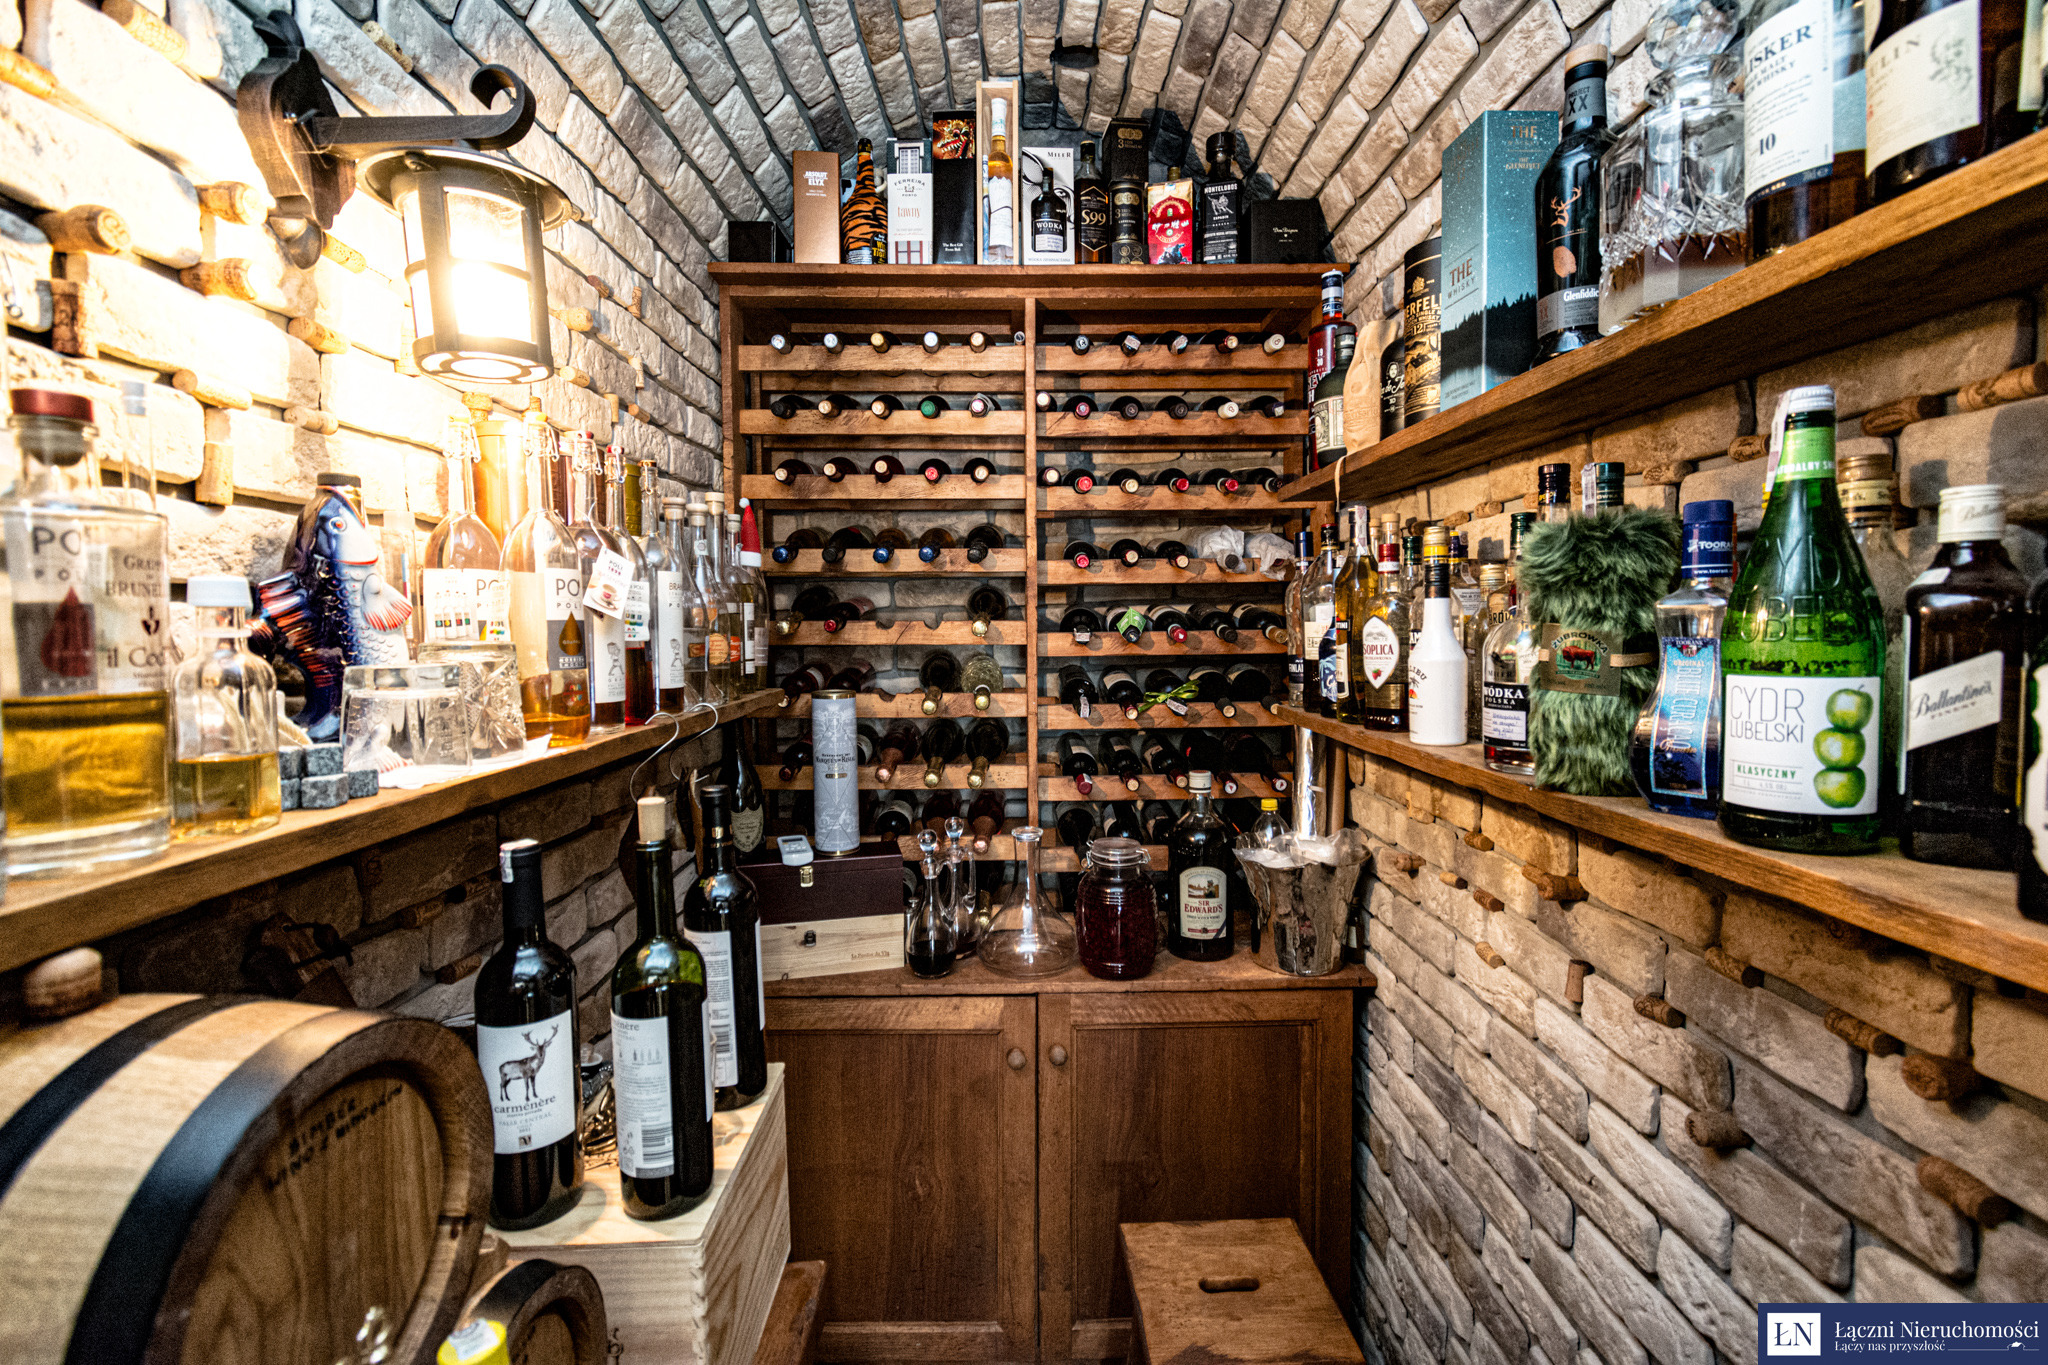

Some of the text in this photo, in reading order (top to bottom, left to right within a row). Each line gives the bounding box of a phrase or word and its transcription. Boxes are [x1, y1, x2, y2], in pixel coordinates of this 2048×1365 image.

[1568, 86, 1591, 99] PROJECT
[1511, 126, 1538, 138] THE
[1760, 133, 1776, 155] 10
[808, 179, 825, 187] ELYX
[894, 178, 925, 187] FERREIRA
[1204, 183, 1238, 194] MONTELOBOS
[897, 206, 920, 218] tawny
[1036, 221, 1063, 230] WÓDKA
[1450, 258, 1473, 287] THE
[1447, 276, 1476, 299] WHISKY
[1413, 324, 1423, 335] 12
[608, 560, 624, 571] POLI
[1363, 643, 1394, 655] SOPLICA
[1673, 659, 1705, 667] ORIGINAL
[1674, 667, 1702, 695] BLUE
[1485, 697, 1516, 705] POLSKA
[1730, 685, 1805, 723] CYDR
[1913, 681, 1993, 721] Ballantine's
[1730, 719, 1804, 743] LUBELSKI
[1737, 763, 1797, 780] KLASYCZNY
[1184, 903, 1224, 914] EDWARD'S
